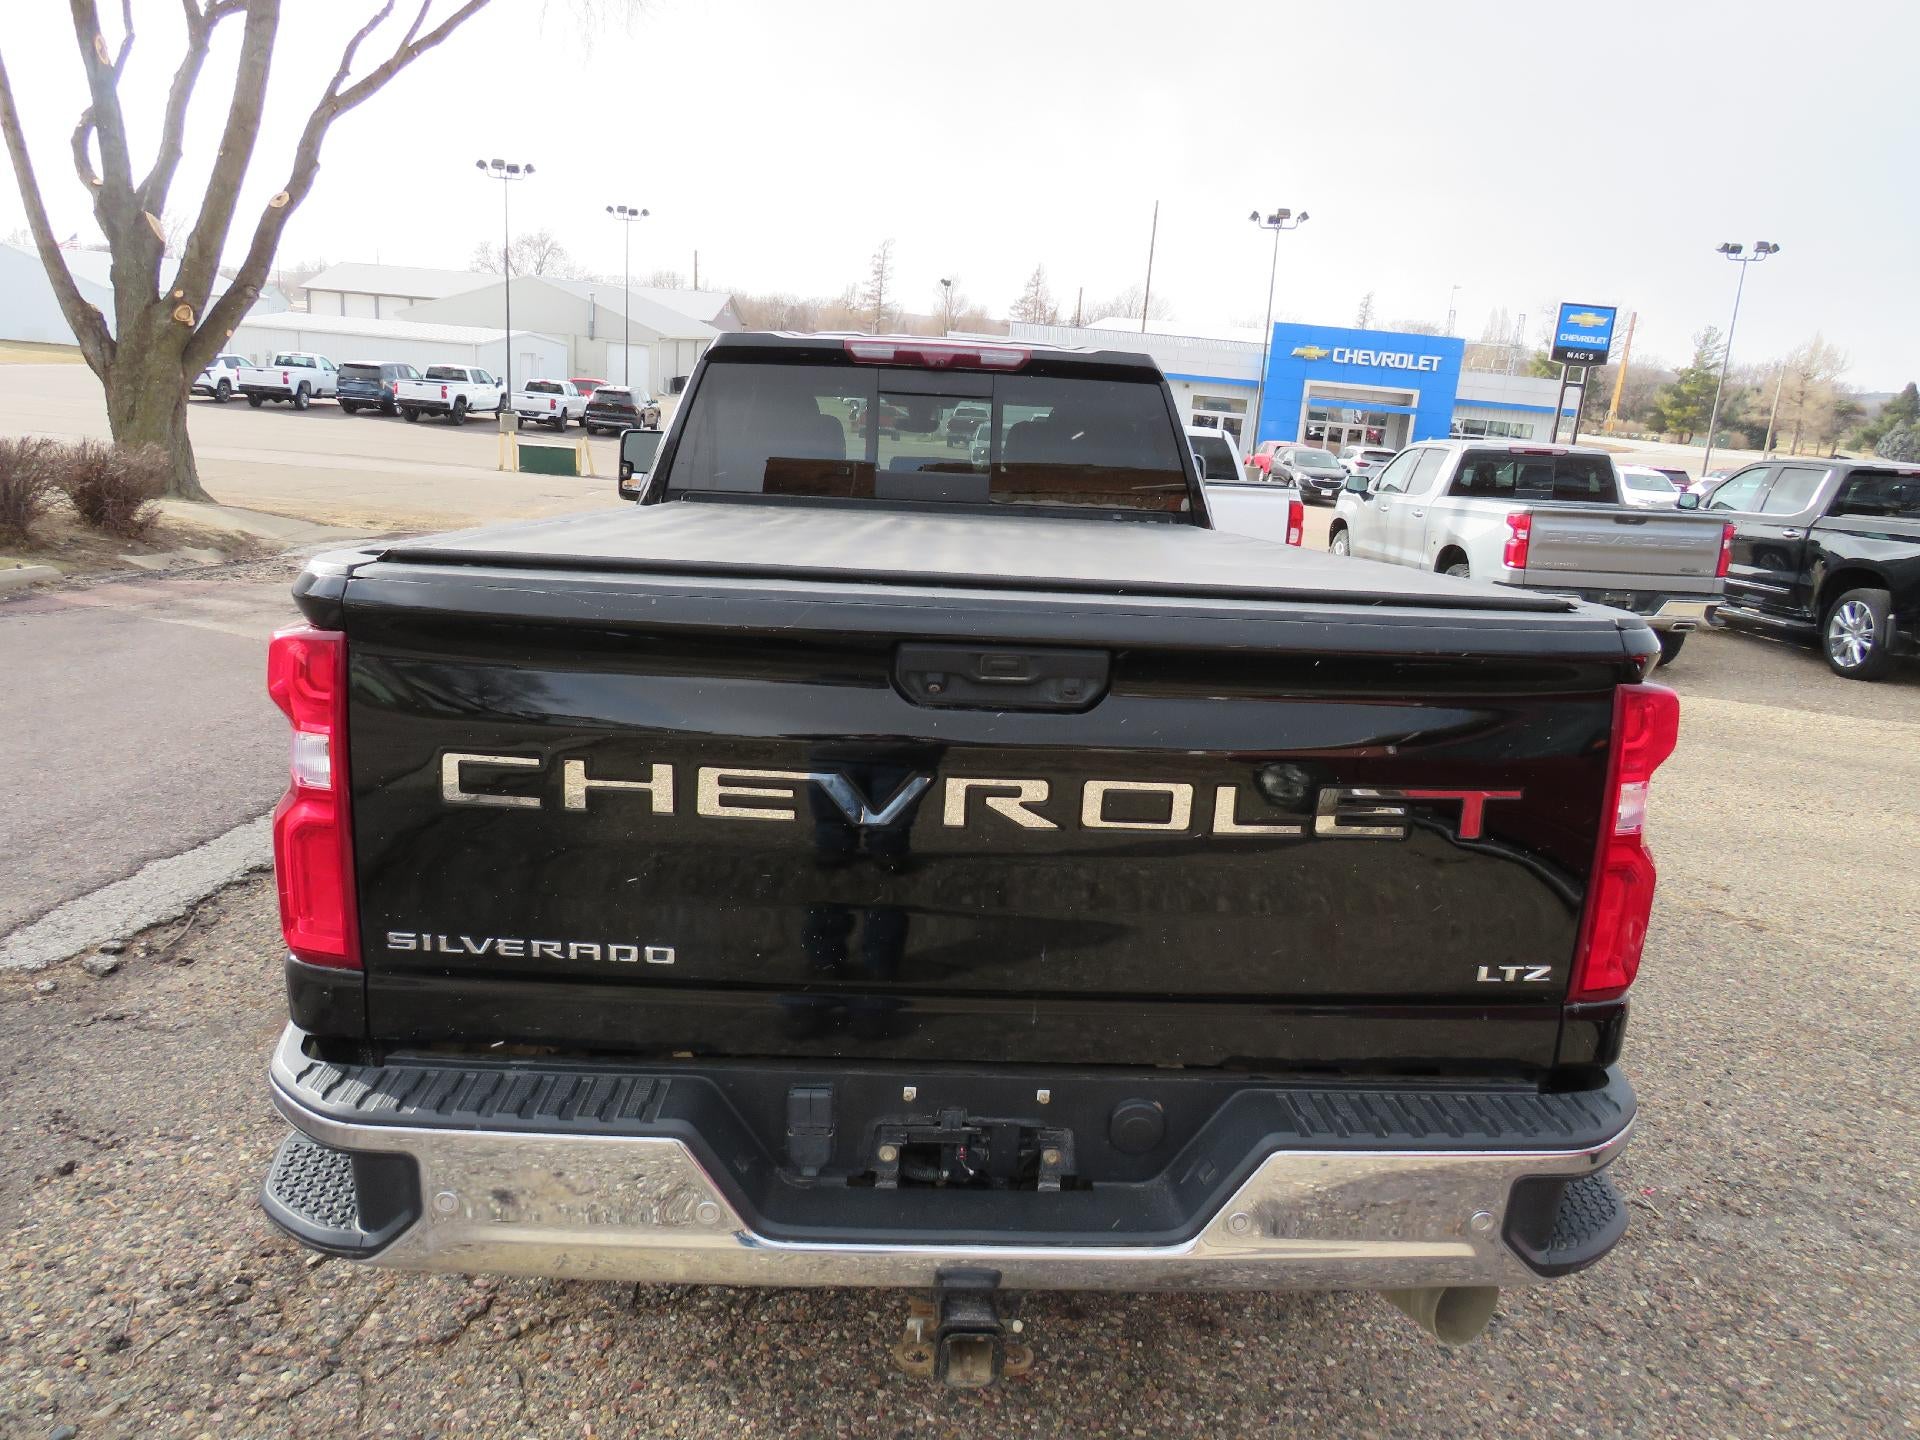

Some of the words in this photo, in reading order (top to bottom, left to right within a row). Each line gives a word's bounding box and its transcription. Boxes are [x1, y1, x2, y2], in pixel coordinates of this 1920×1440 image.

[1560, 333, 1608, 345] CHEVROLET
[1332, 347, 1443, 372] CHEVROLET
[1566, 351, 1594, 361] MAC'S
[441, 752, 1524, 840] CHEVROLET
[386, 931, 676, 965] SILVERADO
[1476, 965, 1552, 982] LTZ
